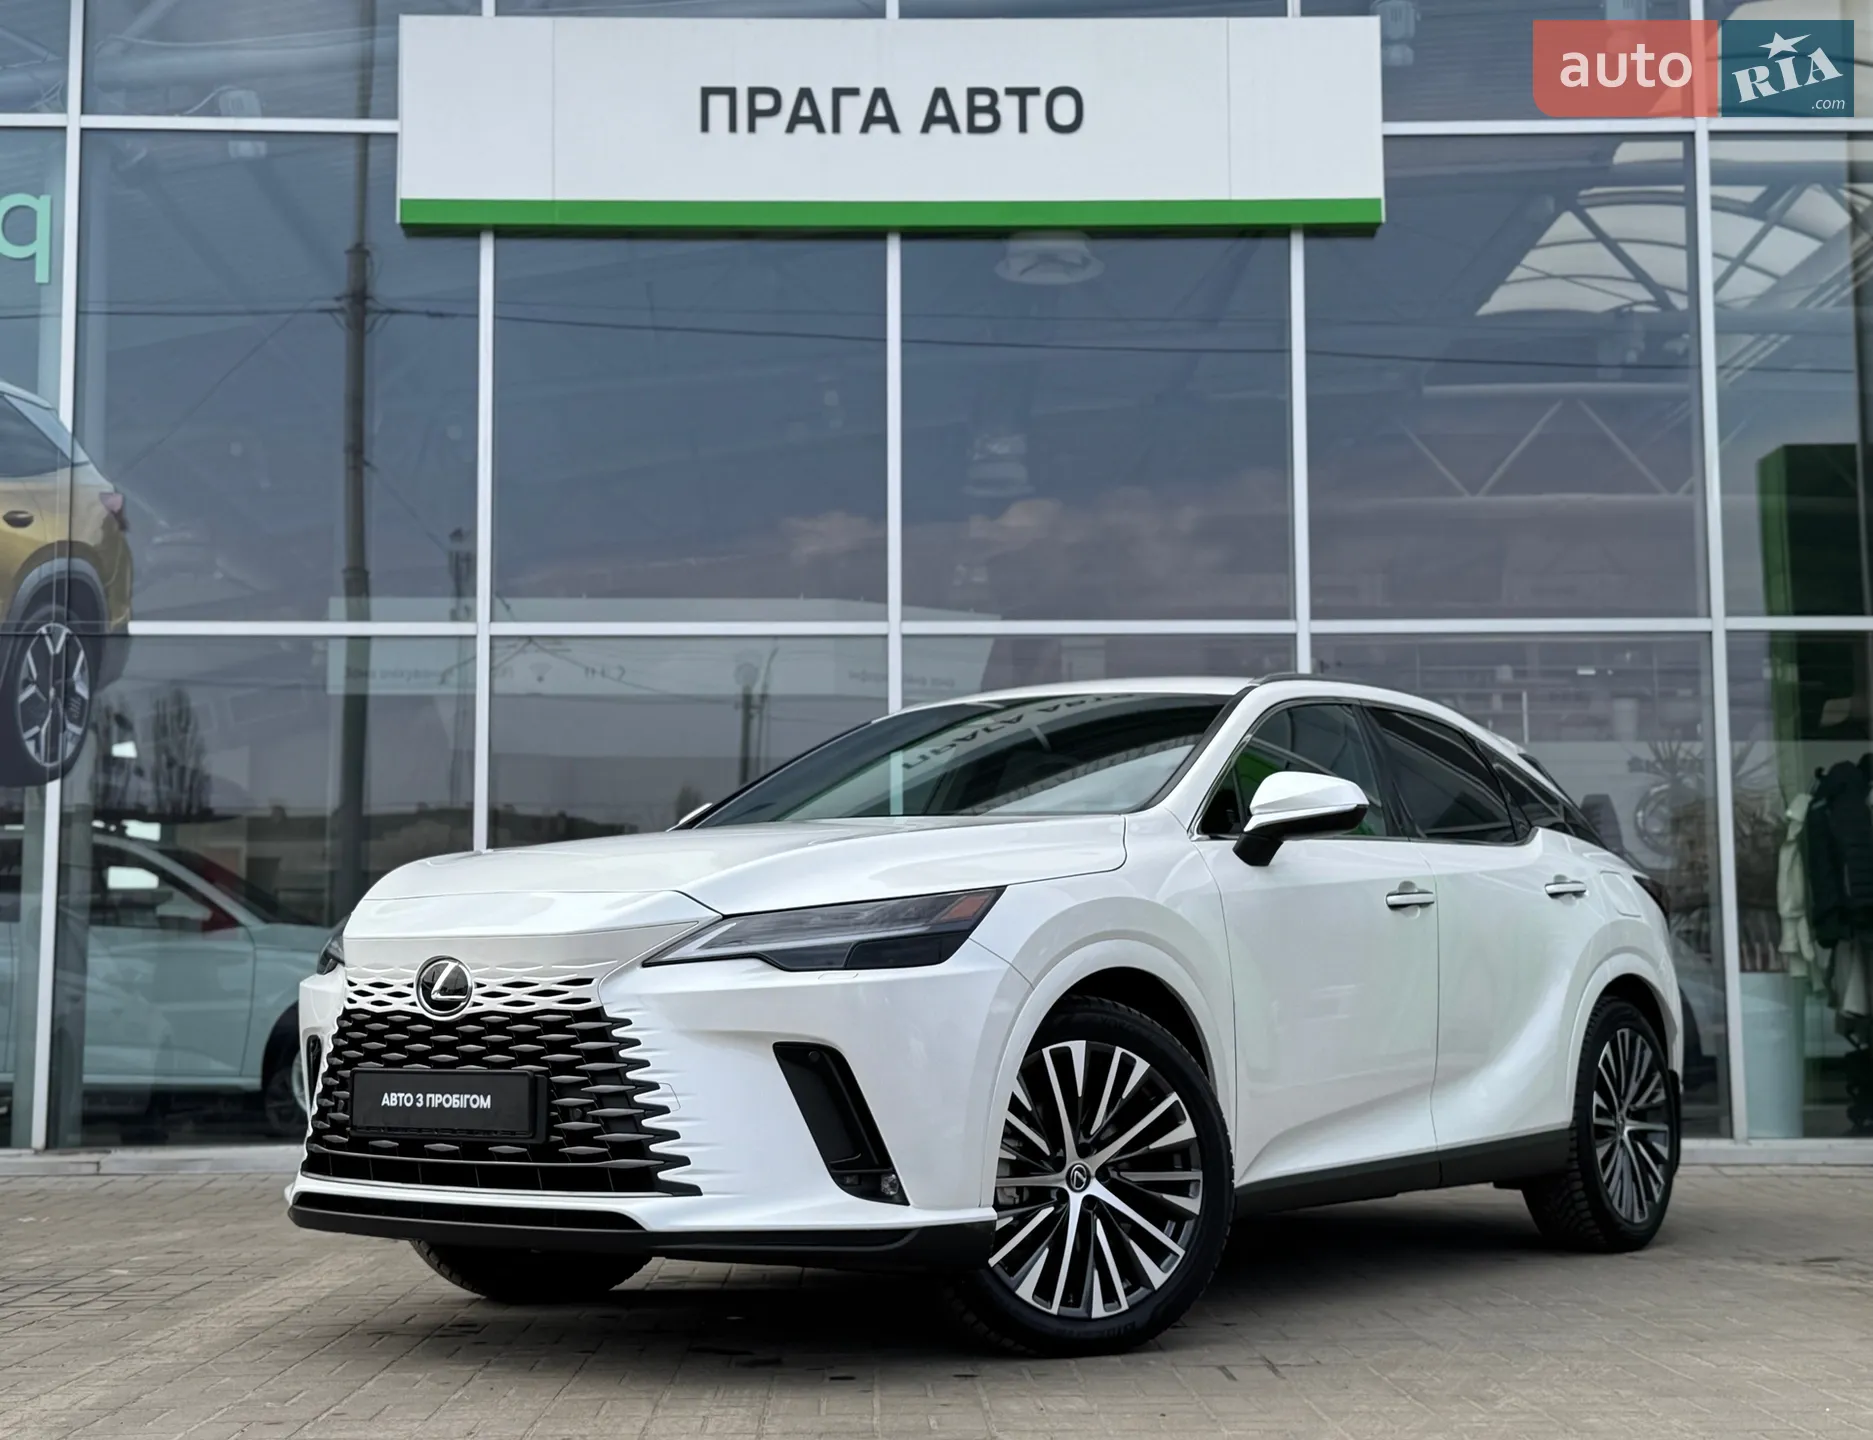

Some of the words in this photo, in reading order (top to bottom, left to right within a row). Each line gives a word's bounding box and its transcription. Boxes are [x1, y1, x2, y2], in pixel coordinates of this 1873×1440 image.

[699, 87, 900, 133] ПРАГА
[920, 86, 1084, 134] АВТО
[381, 1093, 414, 1107] АВТО
[426, 1094, 491, 1109] ПРОБІГОМ
